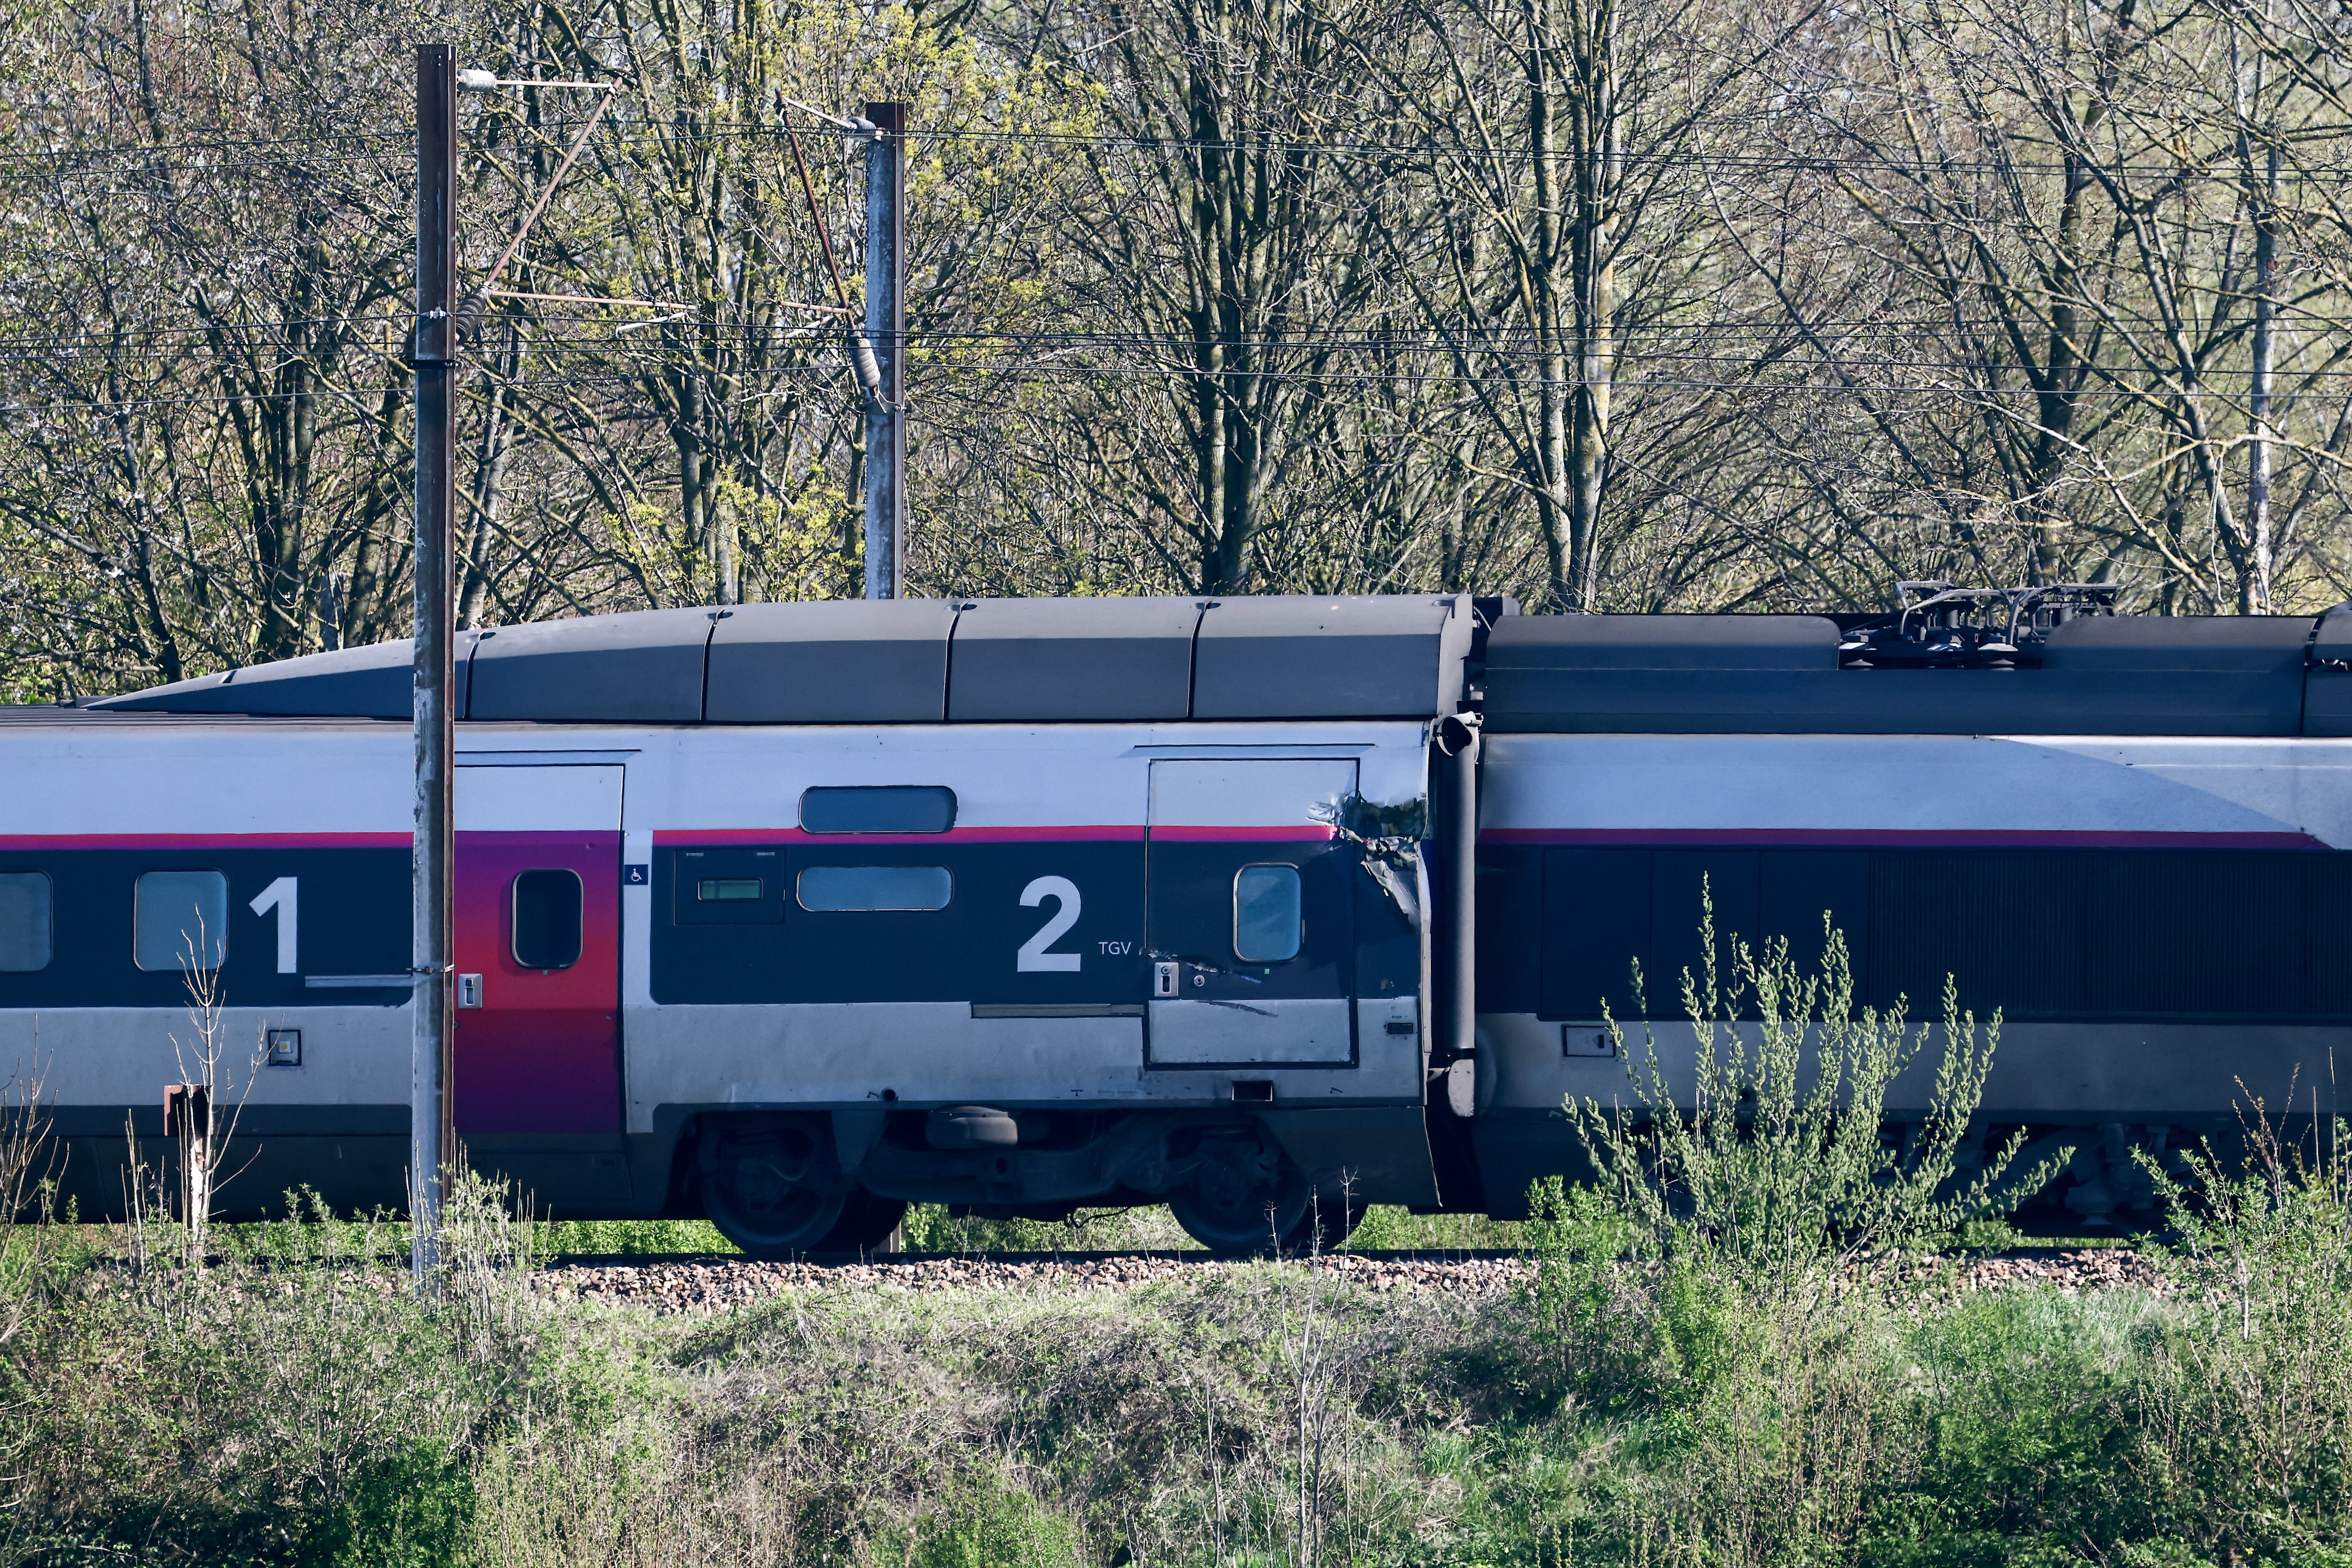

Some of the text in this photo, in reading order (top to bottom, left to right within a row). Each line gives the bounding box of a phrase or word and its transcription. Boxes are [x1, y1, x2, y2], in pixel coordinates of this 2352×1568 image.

[249, 876, 297, 973] 1
[1017, 876, 1081, 972] 2
[1098, 941, 1131, 955] TGV
